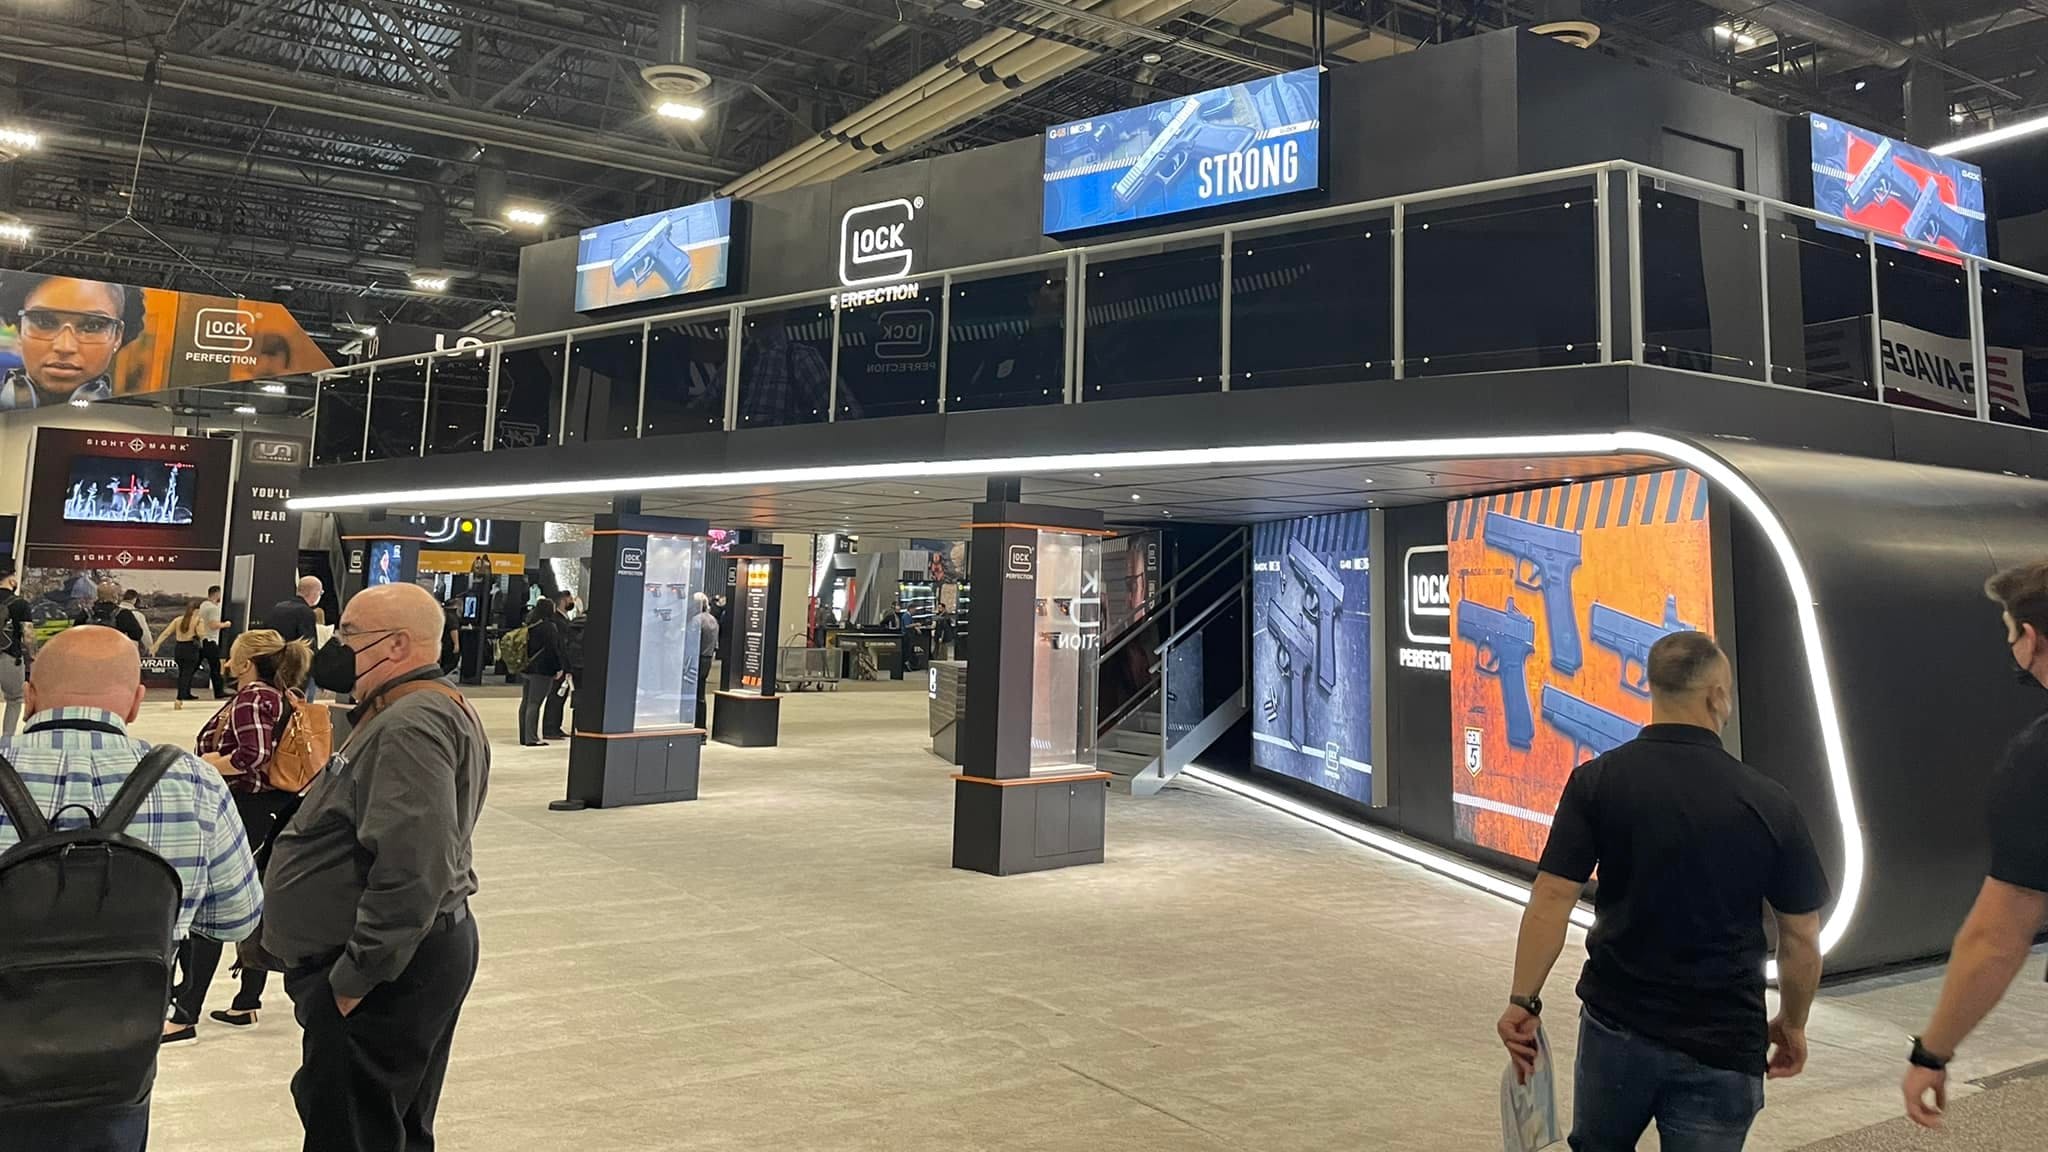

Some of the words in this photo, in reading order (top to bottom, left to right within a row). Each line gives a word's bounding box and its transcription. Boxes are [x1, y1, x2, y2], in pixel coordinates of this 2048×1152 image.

[1198, 139, 1298, 199] STRONG
[185, 352, 257, 365] PERFECTION
[252, 510, 286, 521] WEAR
[259, 533, 275, 544] IT.
